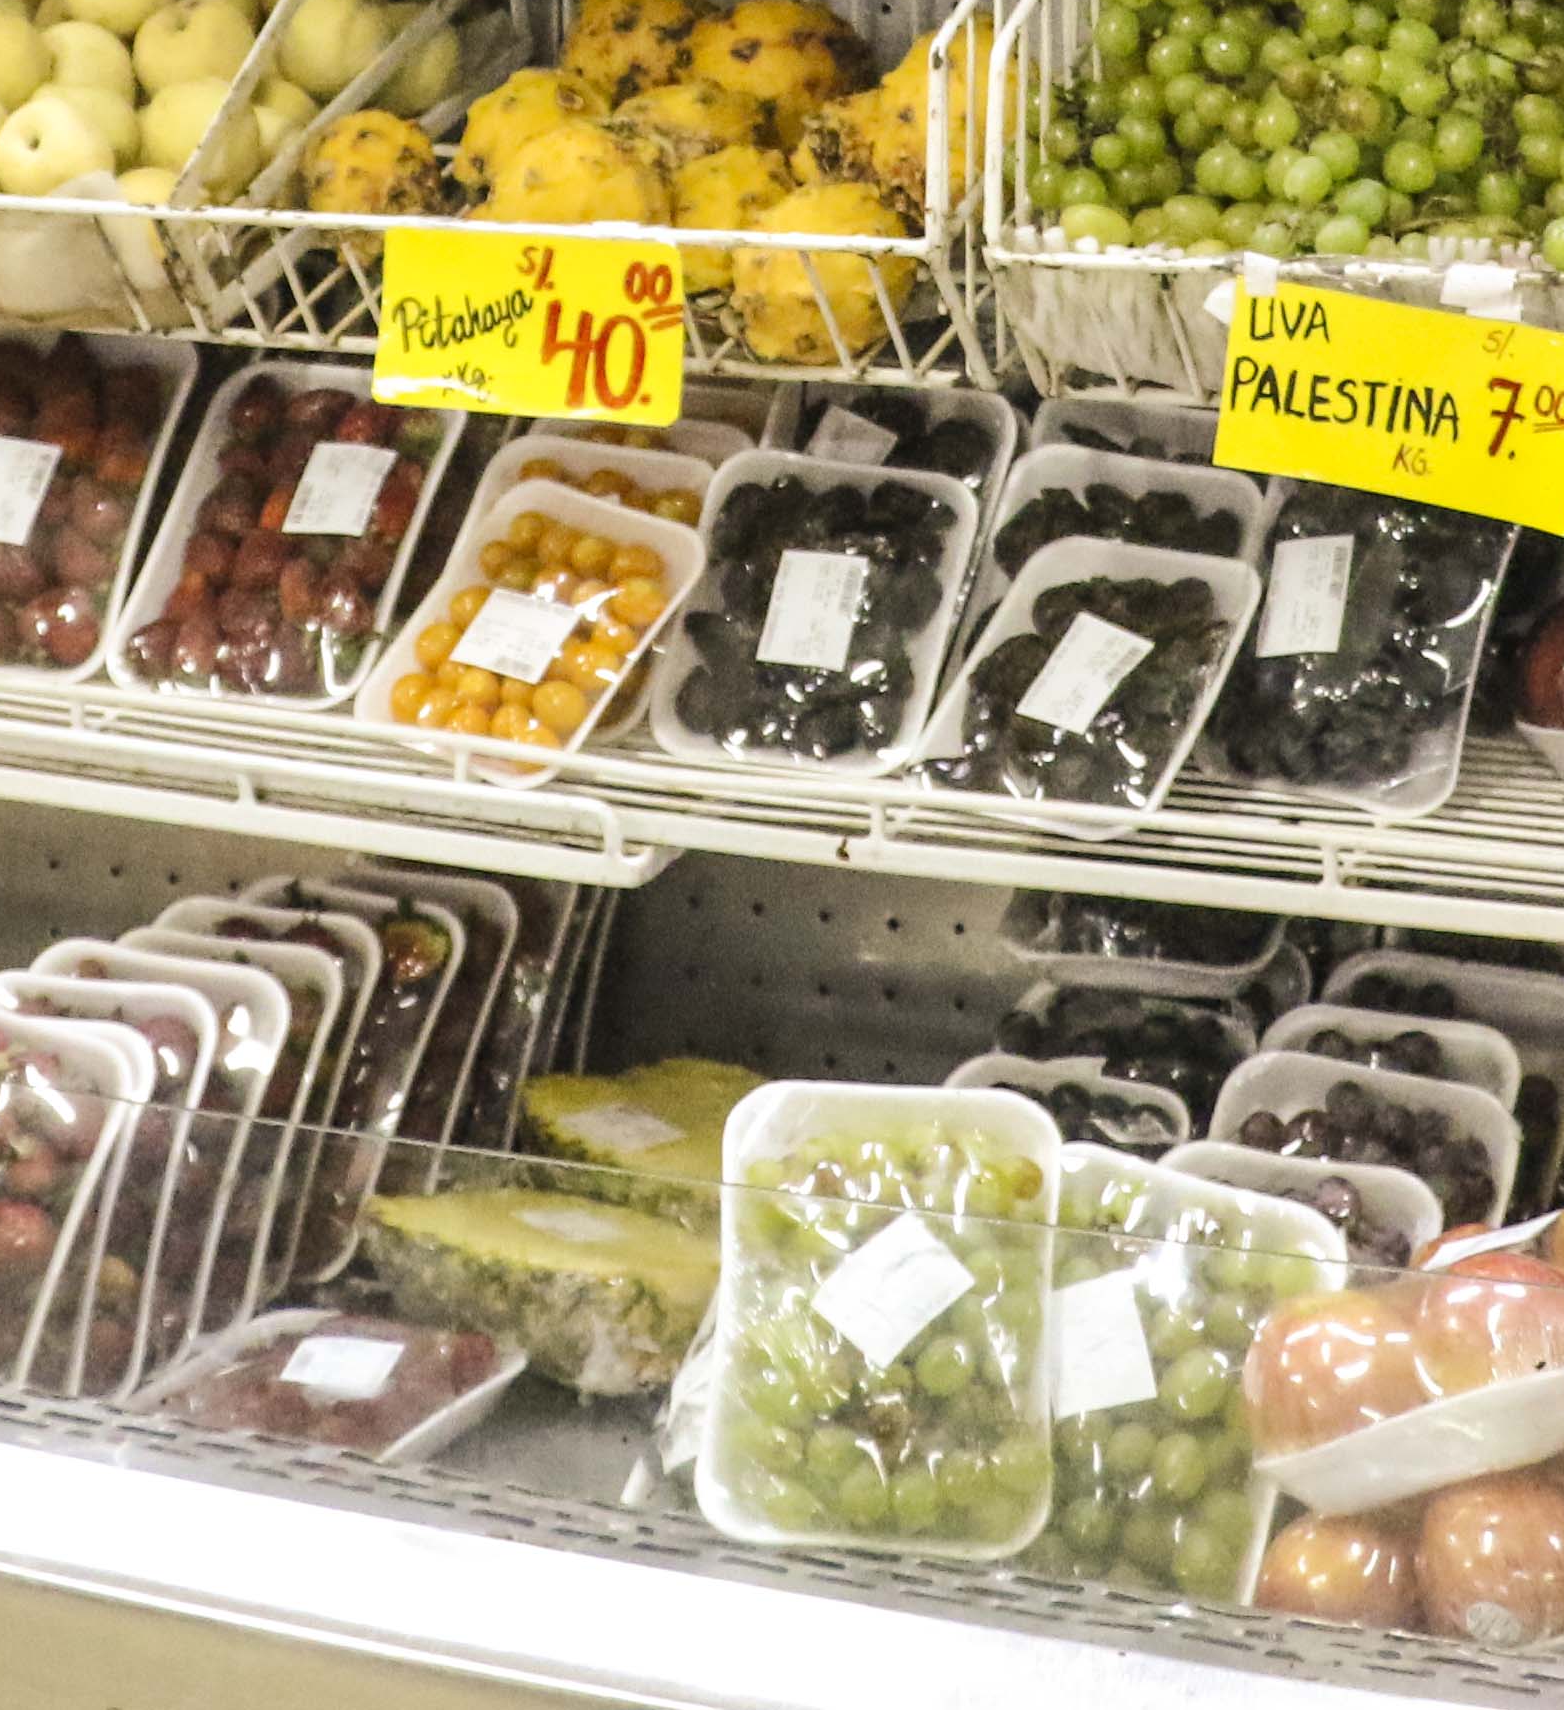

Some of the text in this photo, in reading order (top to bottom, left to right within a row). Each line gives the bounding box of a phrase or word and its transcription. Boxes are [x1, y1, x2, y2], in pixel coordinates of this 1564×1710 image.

[391, 288, 534, 353] Pitahaya
[1250, 295, 1330, 344] UVA
[1231, 354, 1461, 444] PALESTINA
